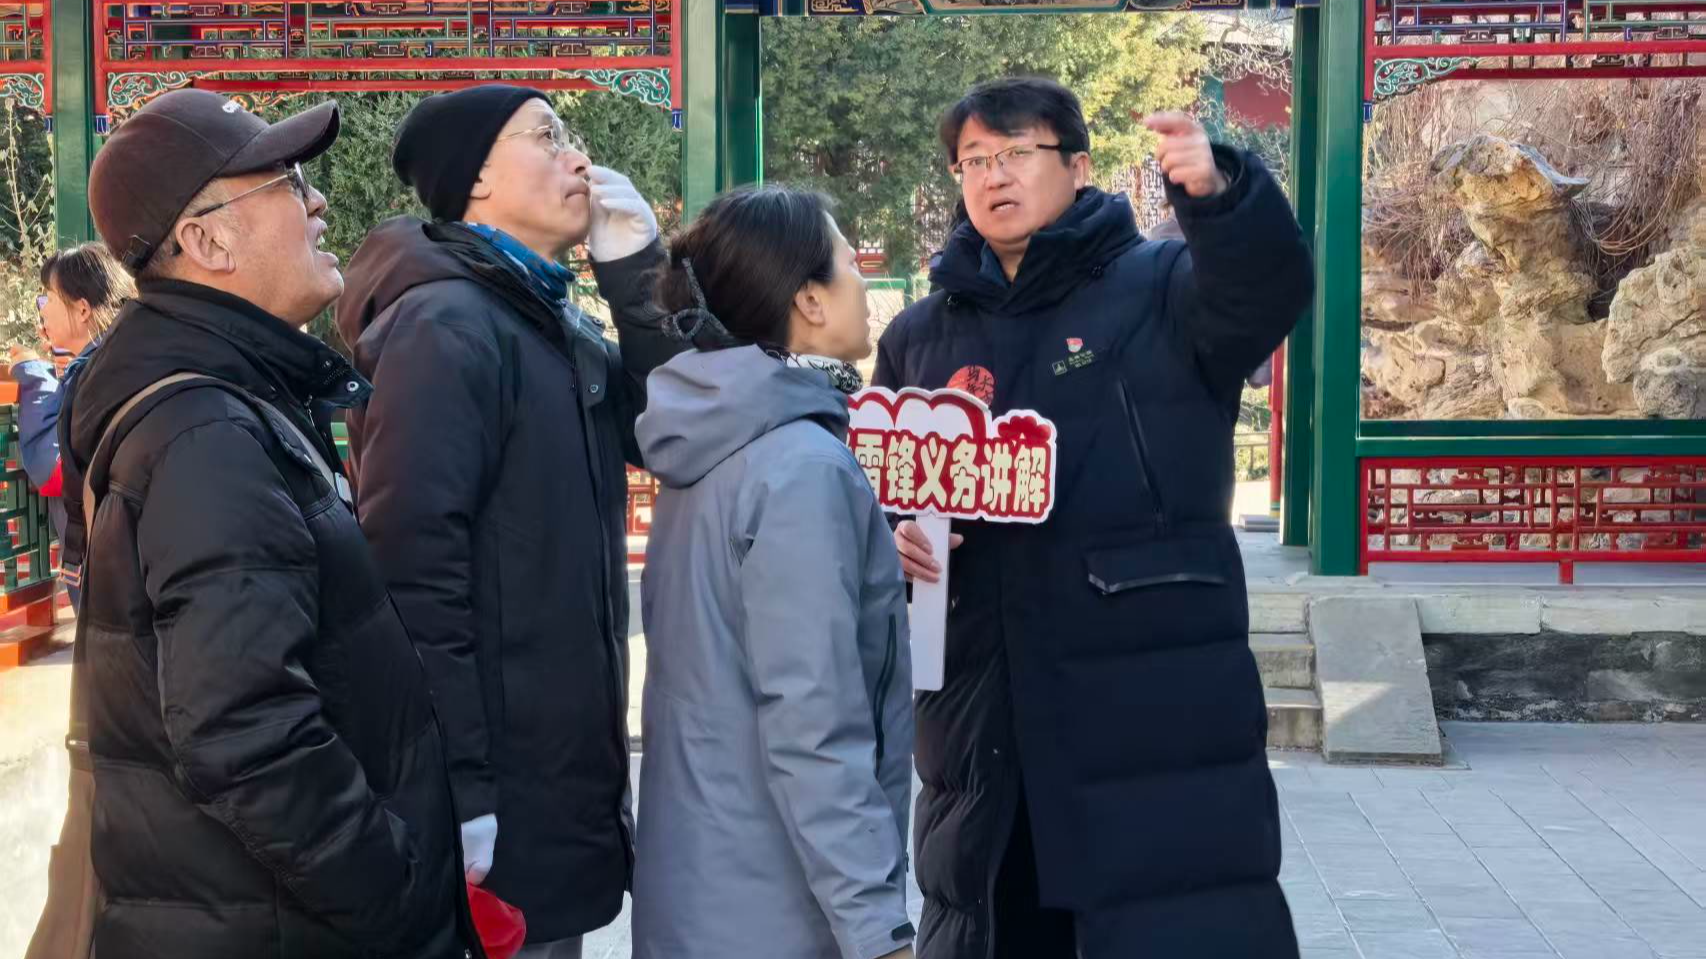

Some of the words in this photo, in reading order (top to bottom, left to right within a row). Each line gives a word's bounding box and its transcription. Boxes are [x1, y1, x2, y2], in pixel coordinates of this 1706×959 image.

[847, 433, 1046, 512] 雷锋义务讲解
